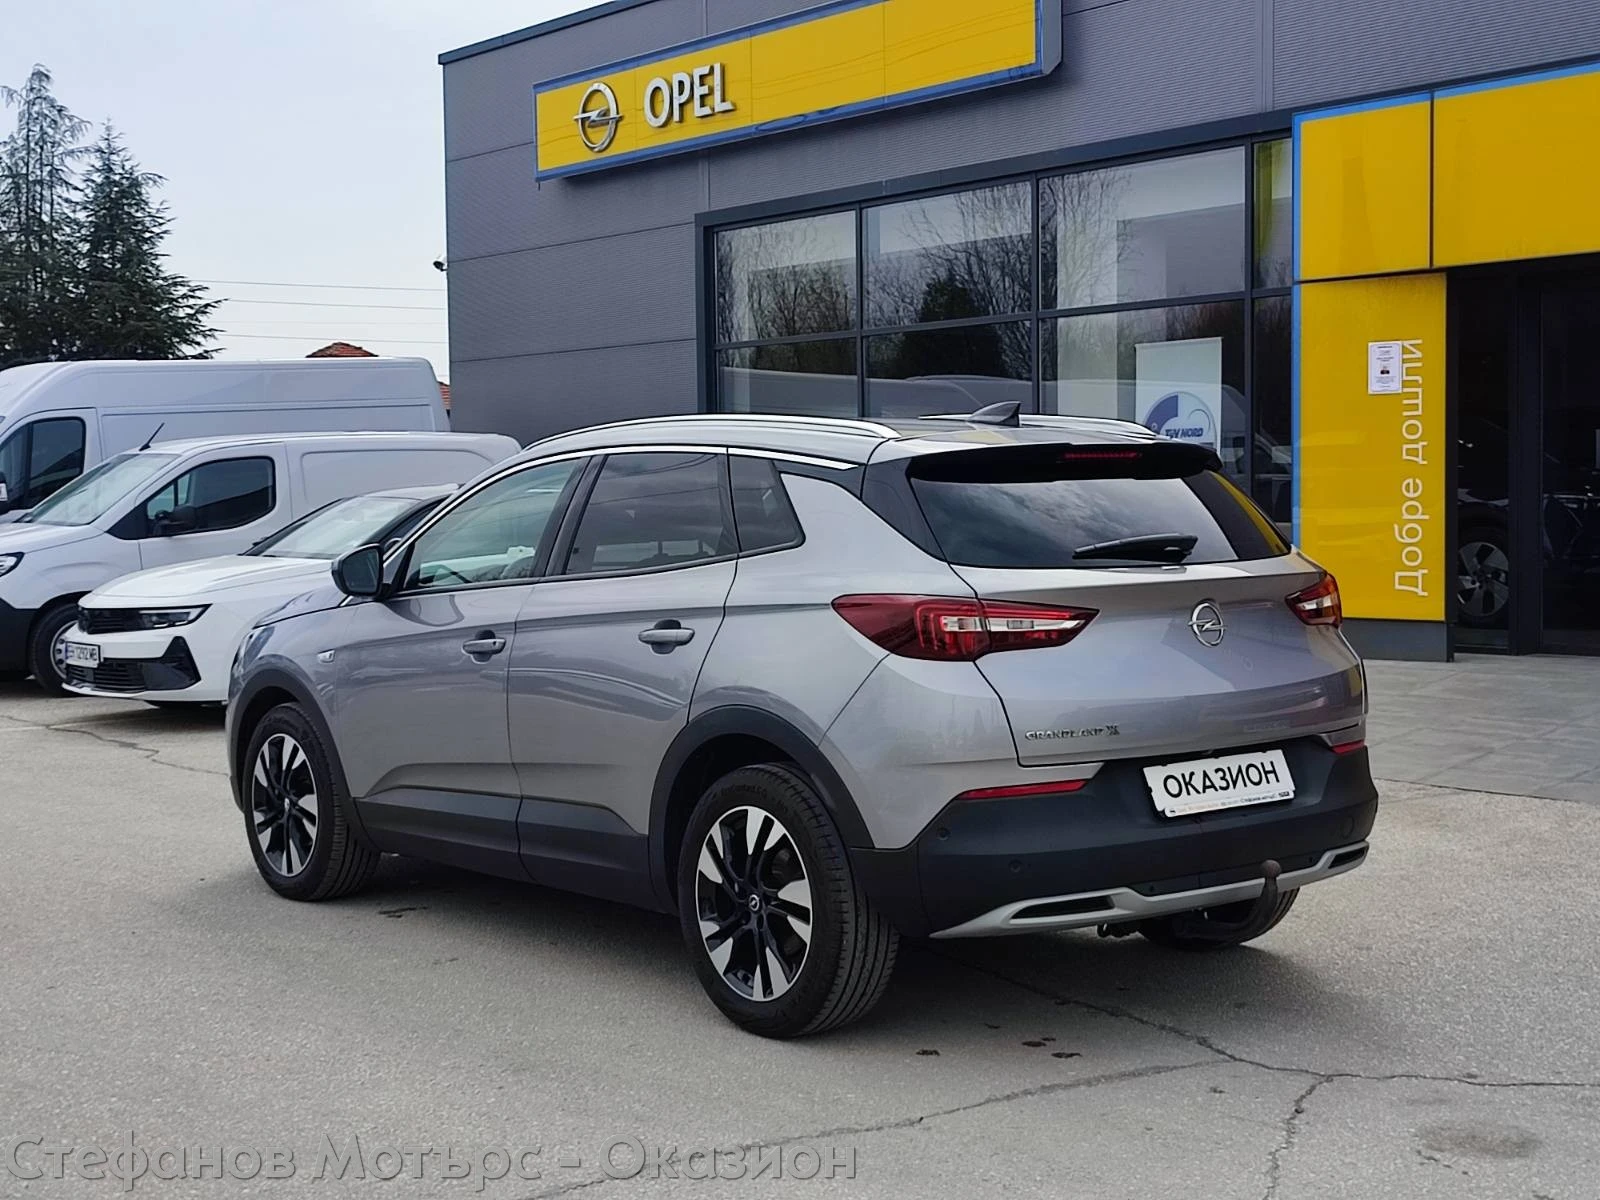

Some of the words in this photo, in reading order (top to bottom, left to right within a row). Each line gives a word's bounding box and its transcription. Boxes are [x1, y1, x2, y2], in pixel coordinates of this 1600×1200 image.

[644, 62, 736, 128] OPEL
[1403, 339, 1428, 464] дошли
[1180, 428, 1203, 438] NORD
[1394, 477, 1430, 596] Добре
[1024, 727, 1104, 741] GRANDLAND
[1104, 722, 1121, 736] X
[1163, 760, 1280, 798] ОКАЗИОН
